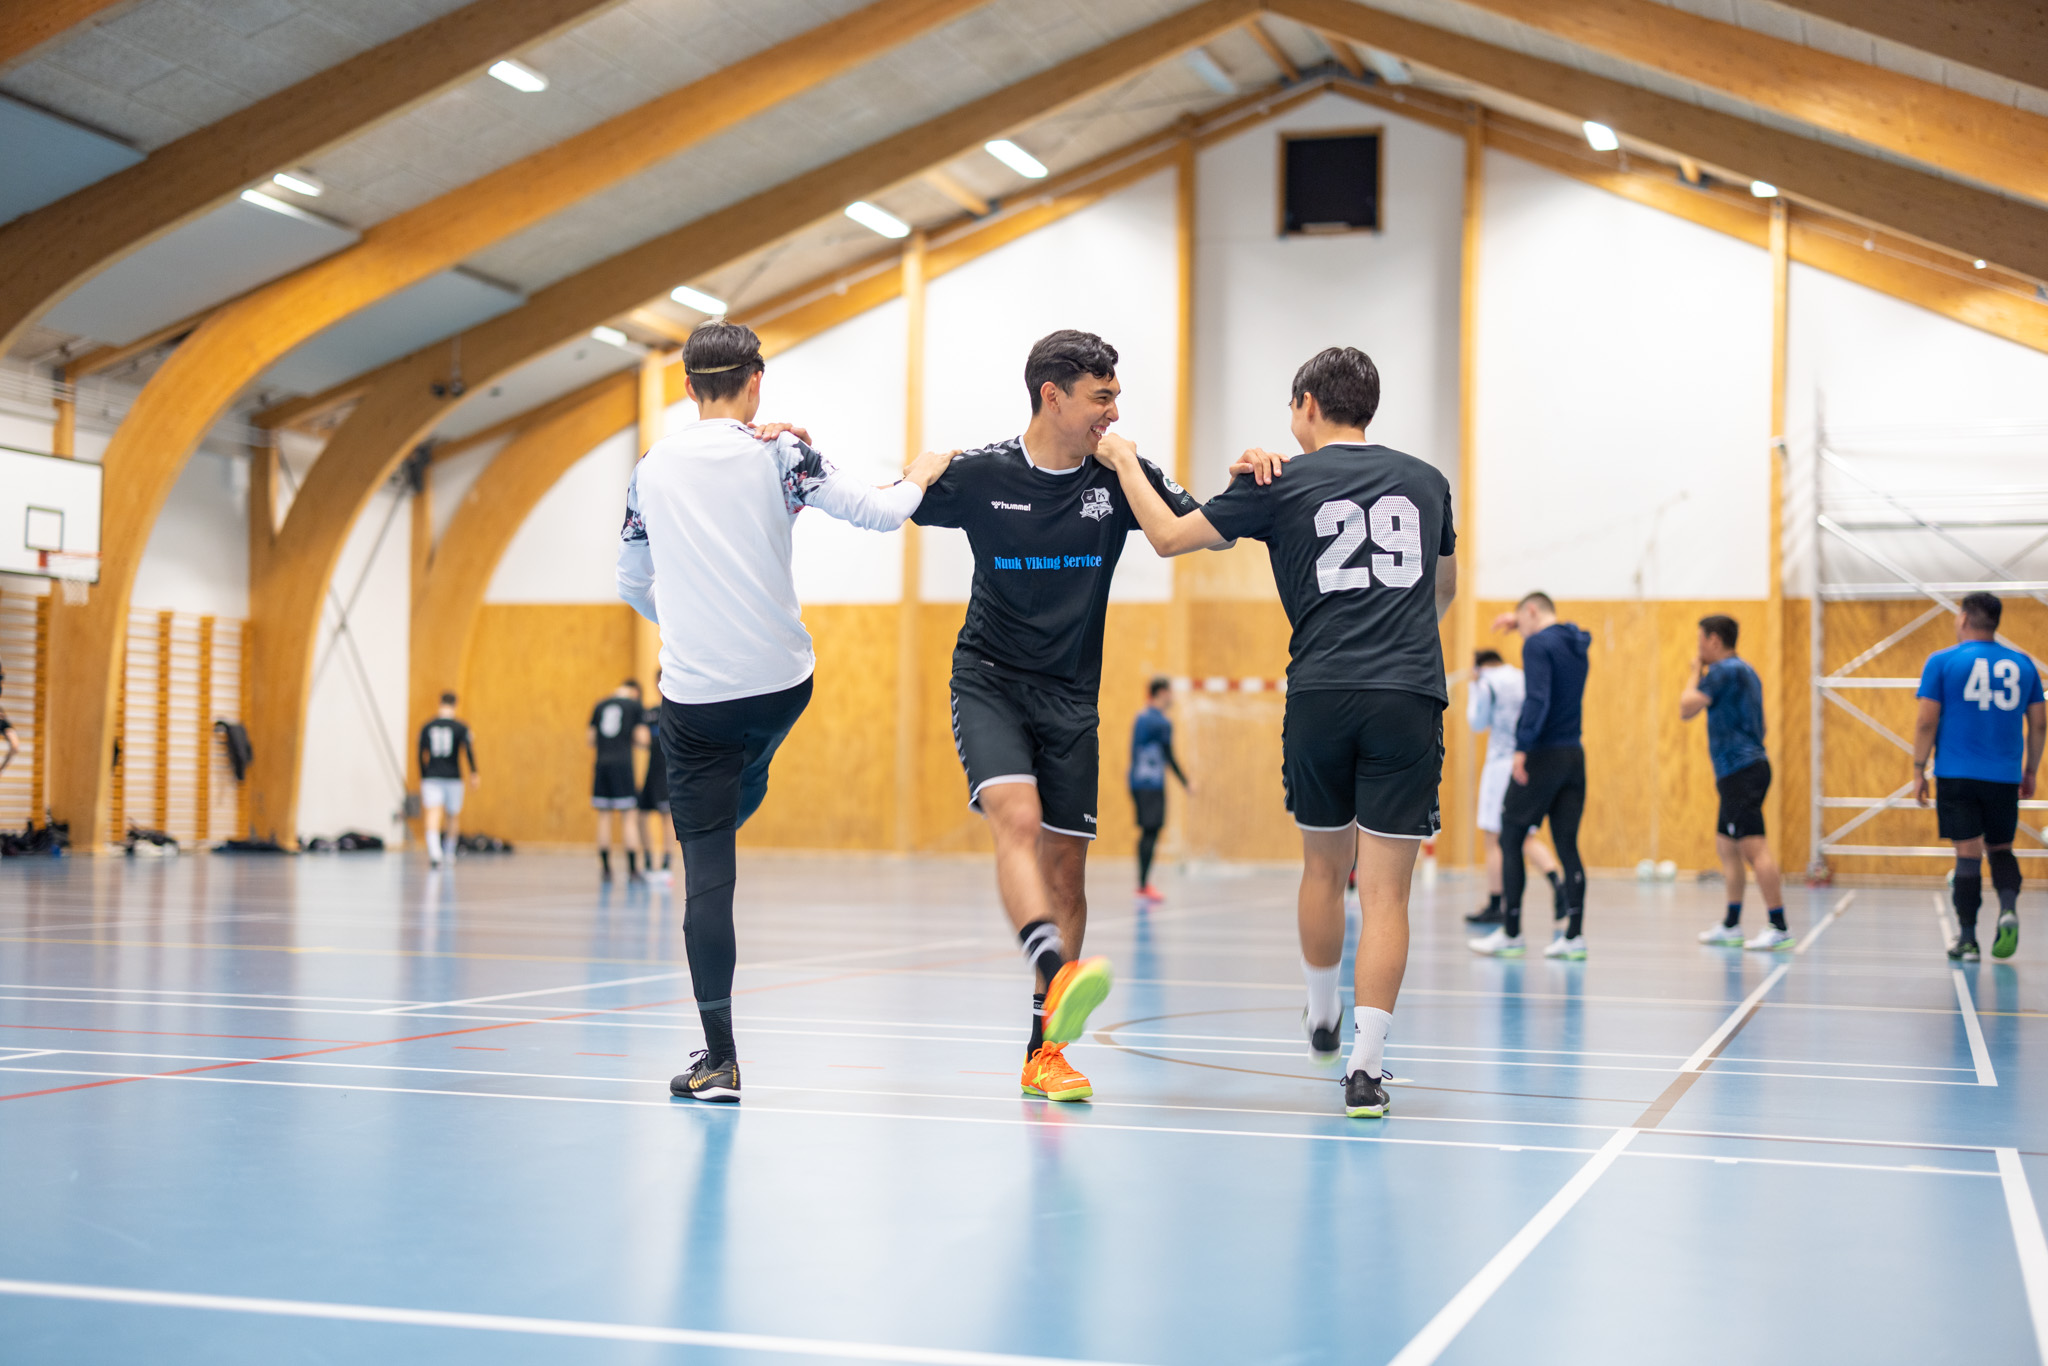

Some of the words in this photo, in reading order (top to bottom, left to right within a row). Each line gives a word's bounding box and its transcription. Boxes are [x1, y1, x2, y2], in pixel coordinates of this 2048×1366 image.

[1001, 501, 1031, 511] hummel
[994, 556, 1022, 570] Nuuk
[1025, 556, 1061, 570] Viking
[1063, 554, 1102, 568] Service
[1314, 495, 1423, 594] 29
[1963, 657, 2020, 711] 43
